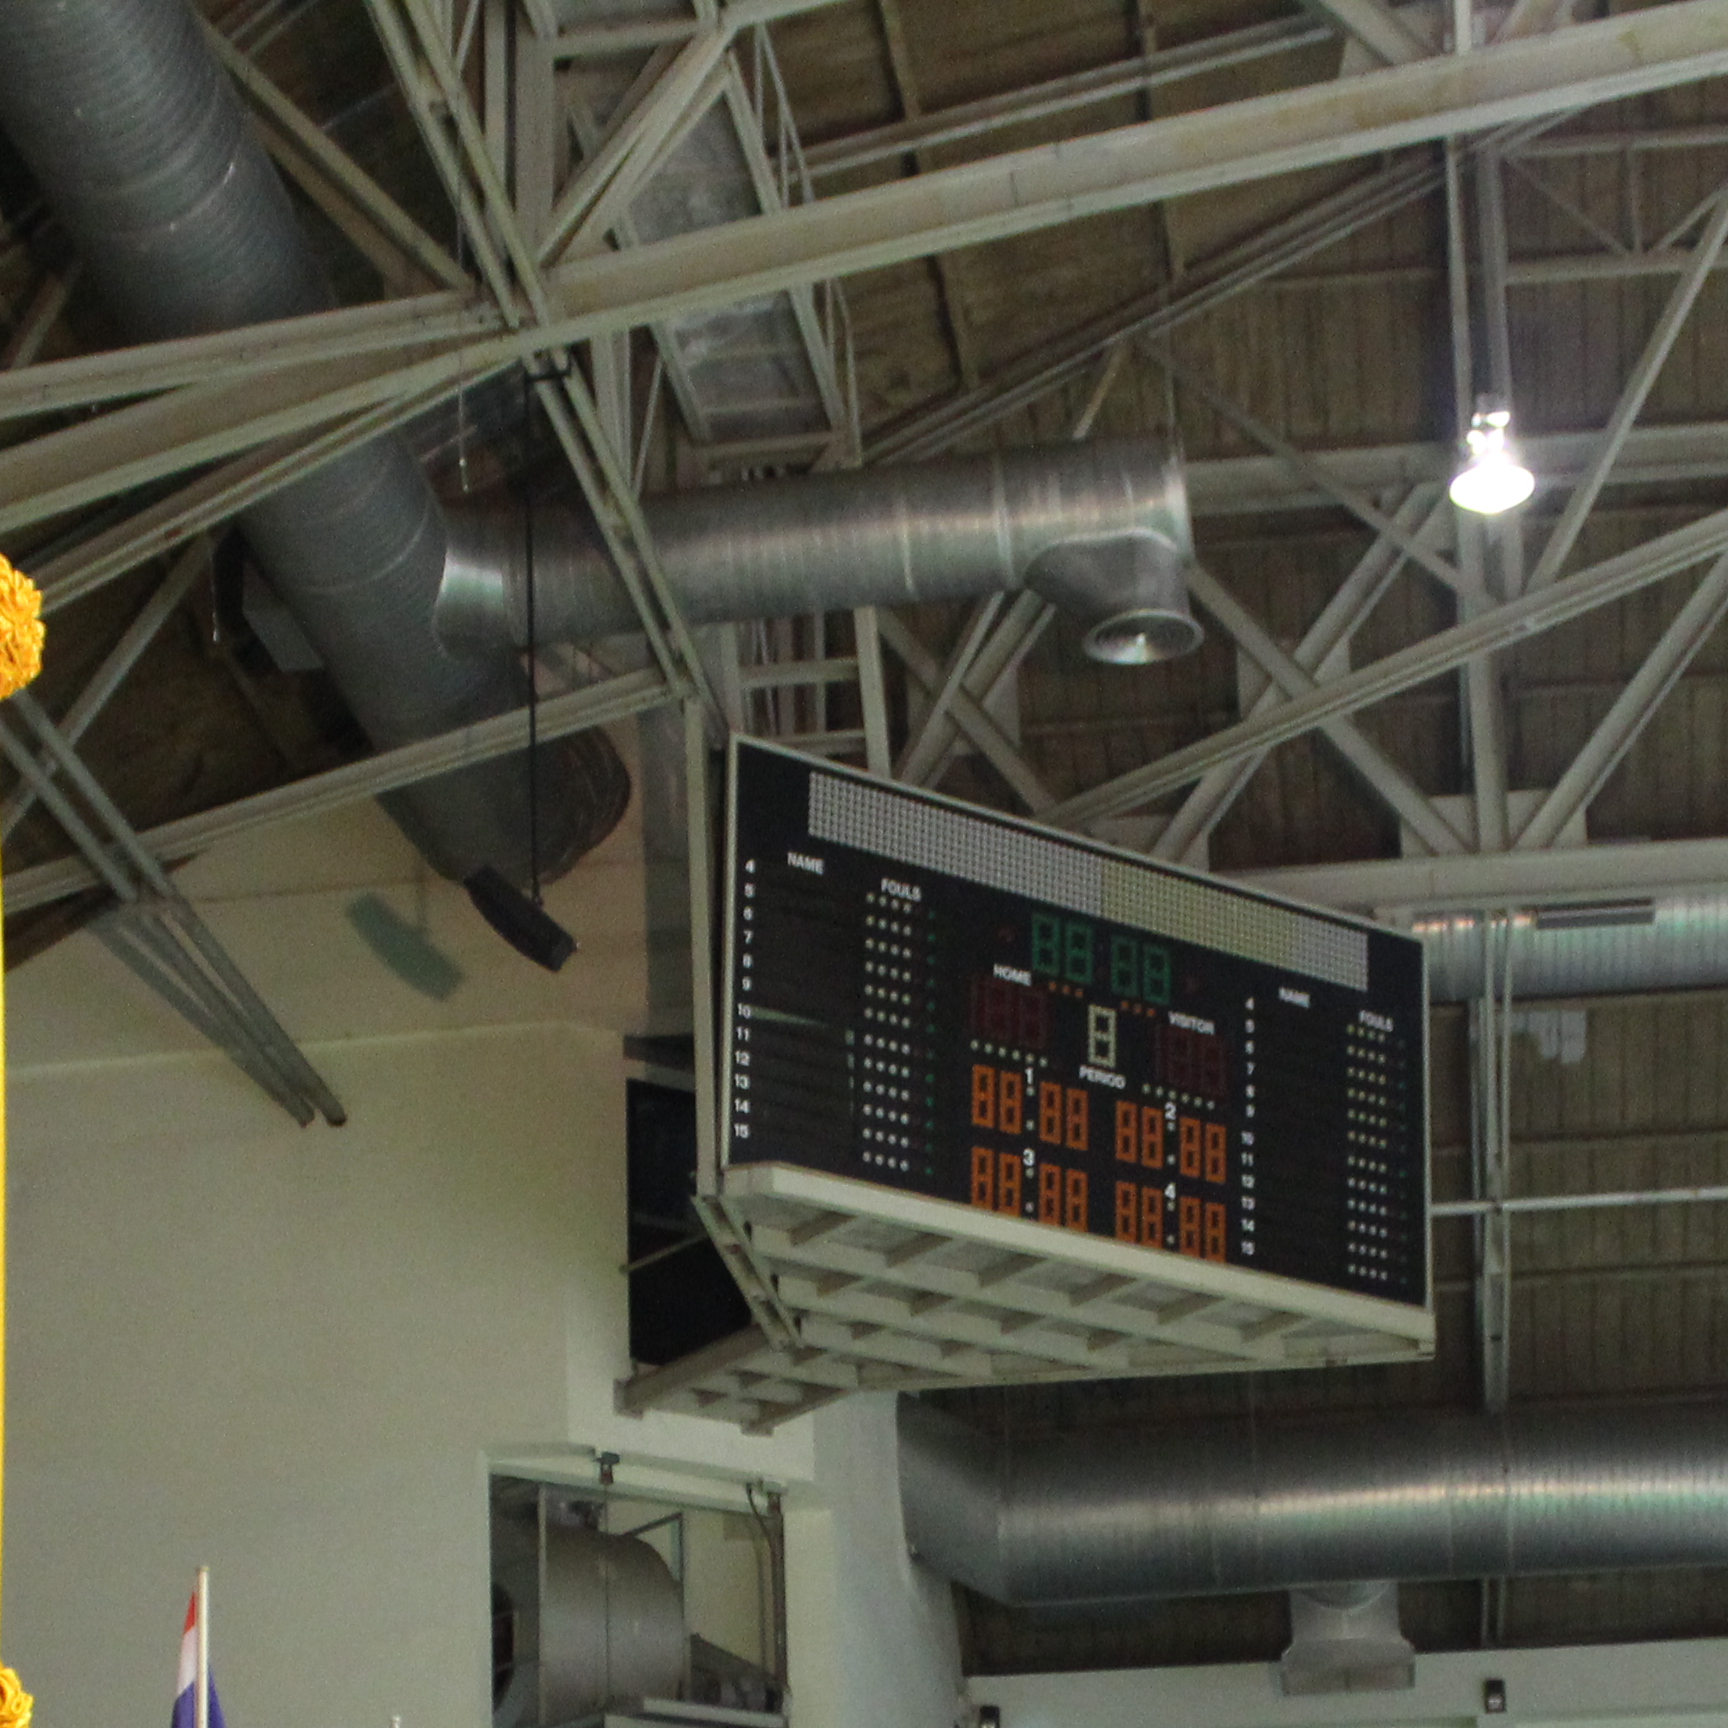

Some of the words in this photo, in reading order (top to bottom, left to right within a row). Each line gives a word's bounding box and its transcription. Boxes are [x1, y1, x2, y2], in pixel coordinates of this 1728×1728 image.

[745, 859, 755, 874] 4
[787, 851, 824, 876] NAME
[880, 878, 922, 902] FOULS
[743, 930, 754, 945] 7
[742, 976, 752, 991] 9
[993, 963, 1032, 987] HOME
[737, 1003, 752, 1019] 10
[1168, 1011, 1215, 1036] VISITOR
[736, 1027, 750, 1042] 11
[735, 1050, 751, 1067] 12
[734, 1074, 751, 1090] 13
[1024, 1067, 1033, 1085] 1
[1079, 1065, 1126, 1090] PERIOD
[734, 1098, 751, 1114] 14
[1164, 1102, 1176, 1119] 2
[734, 1122, 750, 1139] 15
[1023, 1148, 1035, 1167] 3
[1241, 1152, 1254, 1168] 11
[1164, 1182, 1176, 1200] 4
[1241, 1217, 1255, 1233] 14
